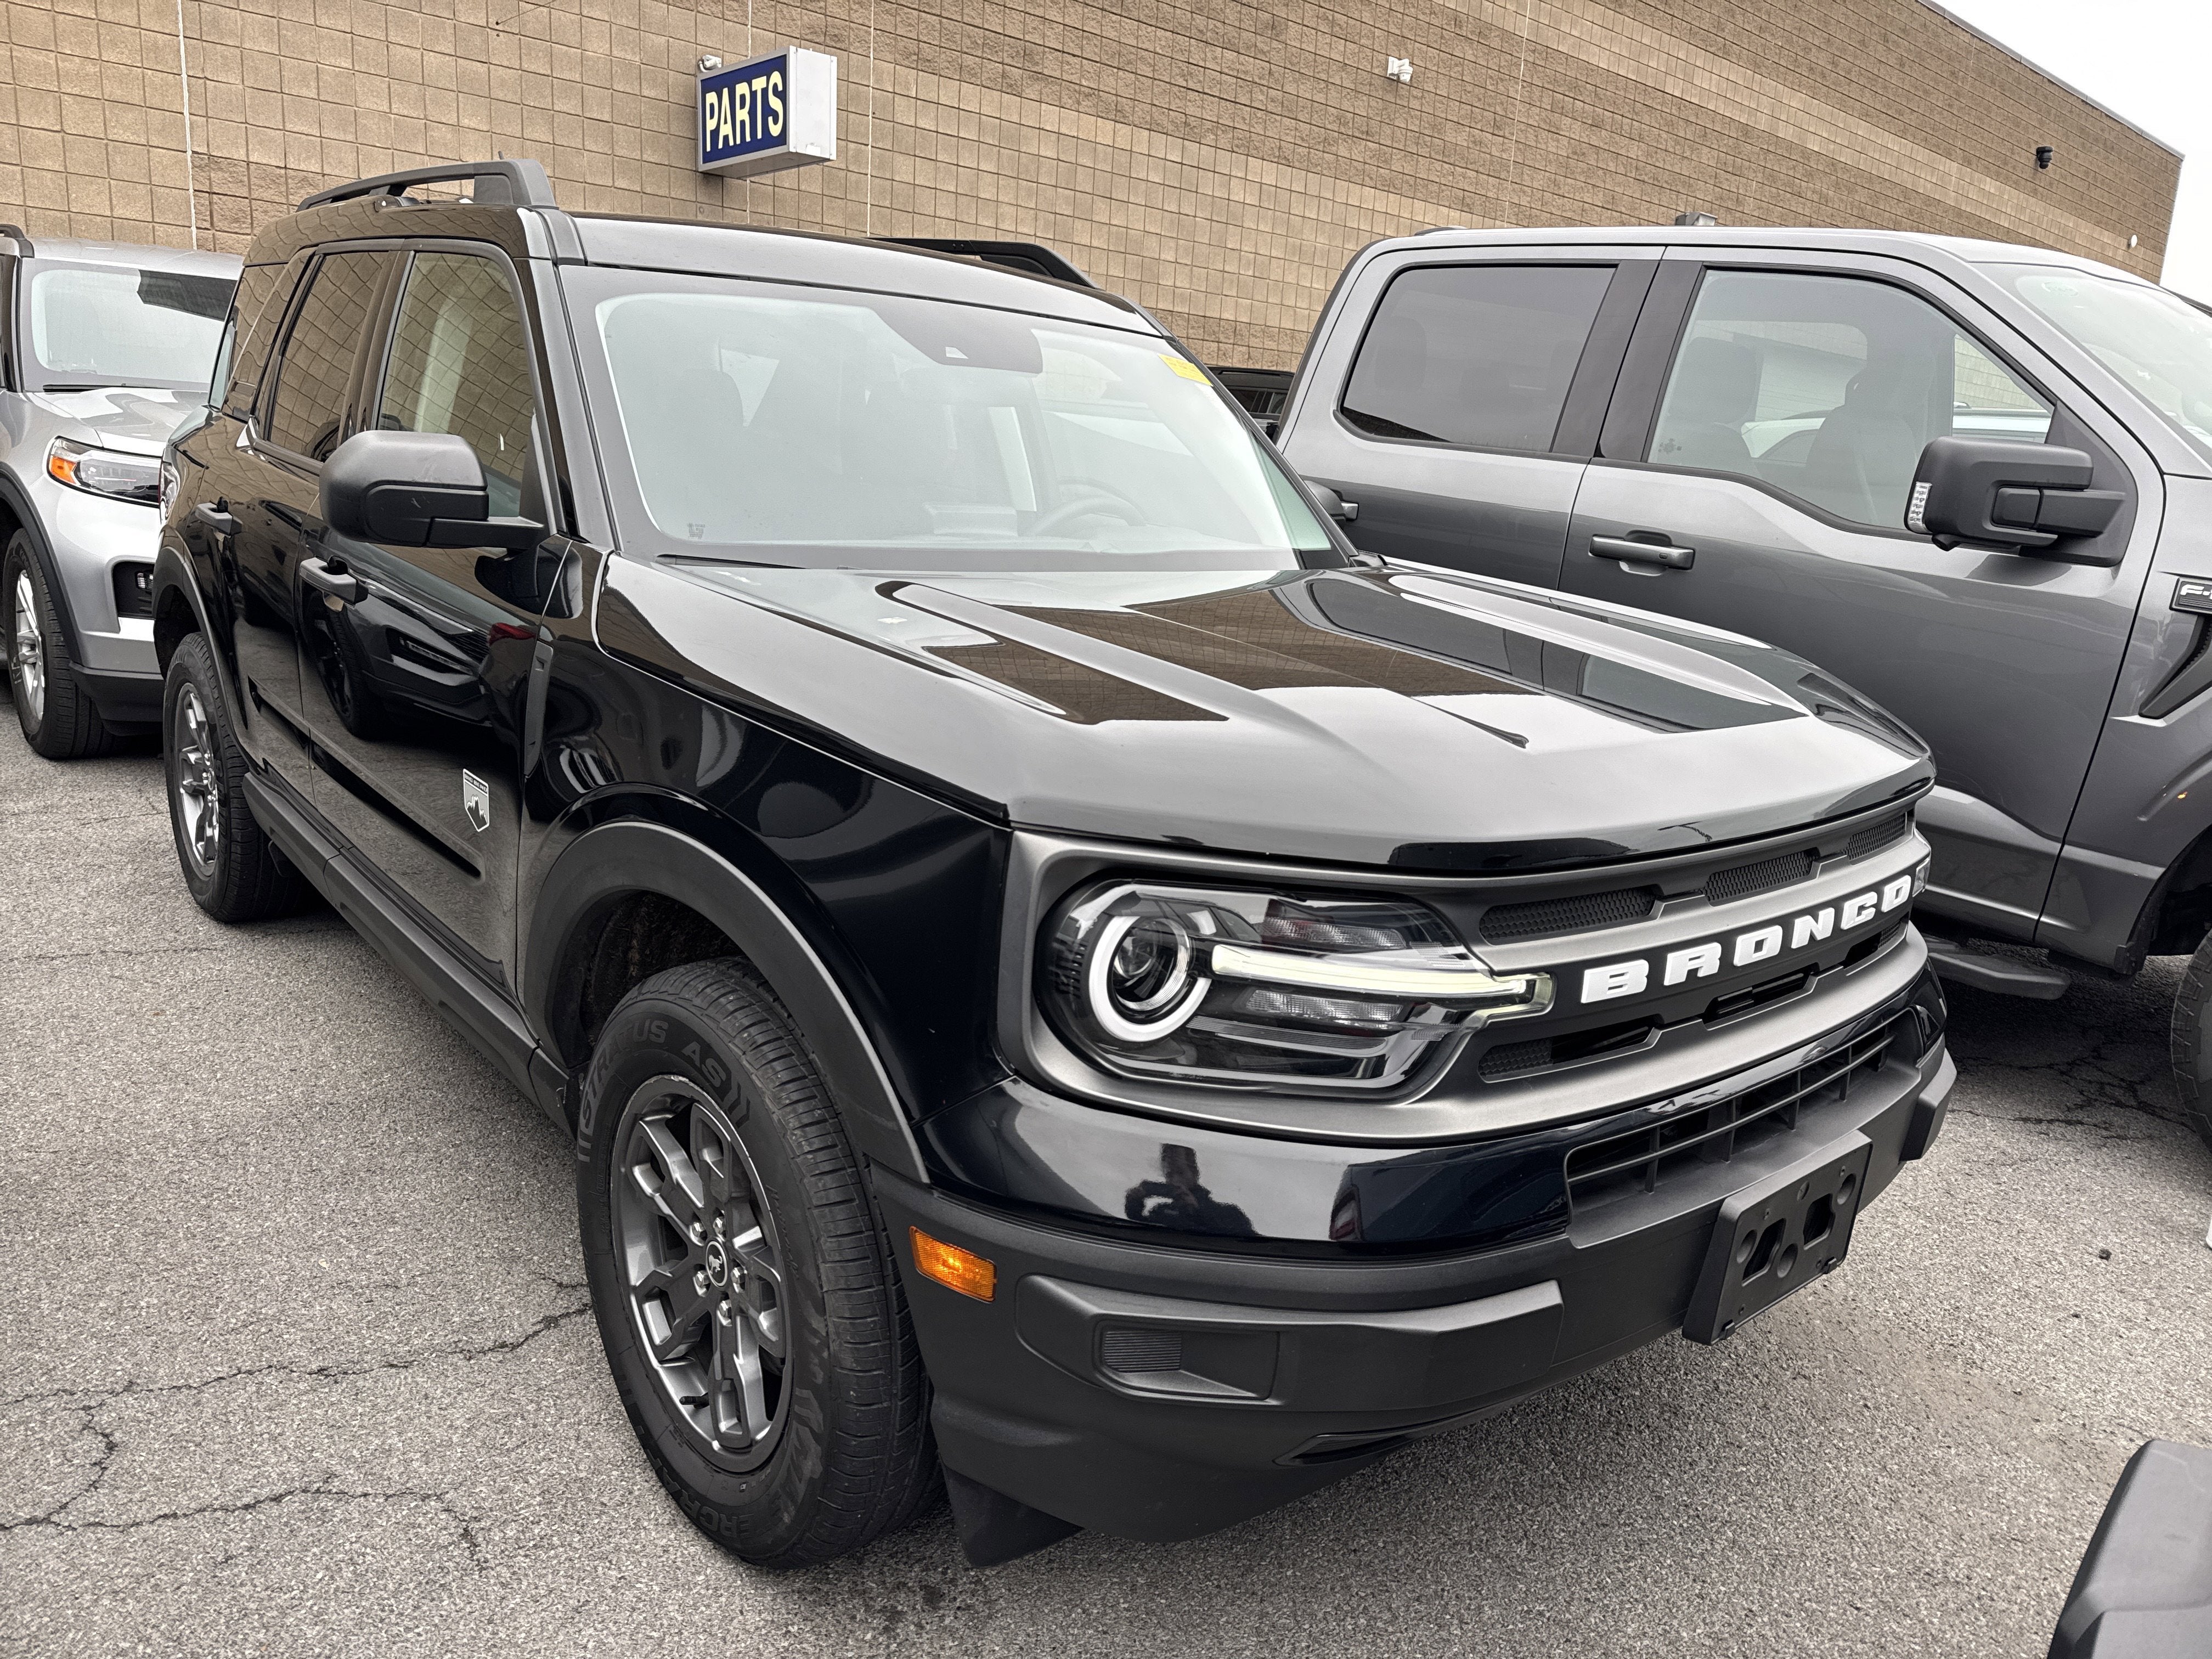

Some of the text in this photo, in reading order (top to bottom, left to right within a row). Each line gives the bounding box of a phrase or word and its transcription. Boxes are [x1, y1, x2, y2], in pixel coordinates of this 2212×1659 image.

[706, 71, 783, 152] PARTS
[473, 780, 487, 792] BEND
[1581, 875, 1911, 1003] BRONCO
[681, 1041, 726, 1088] AS
